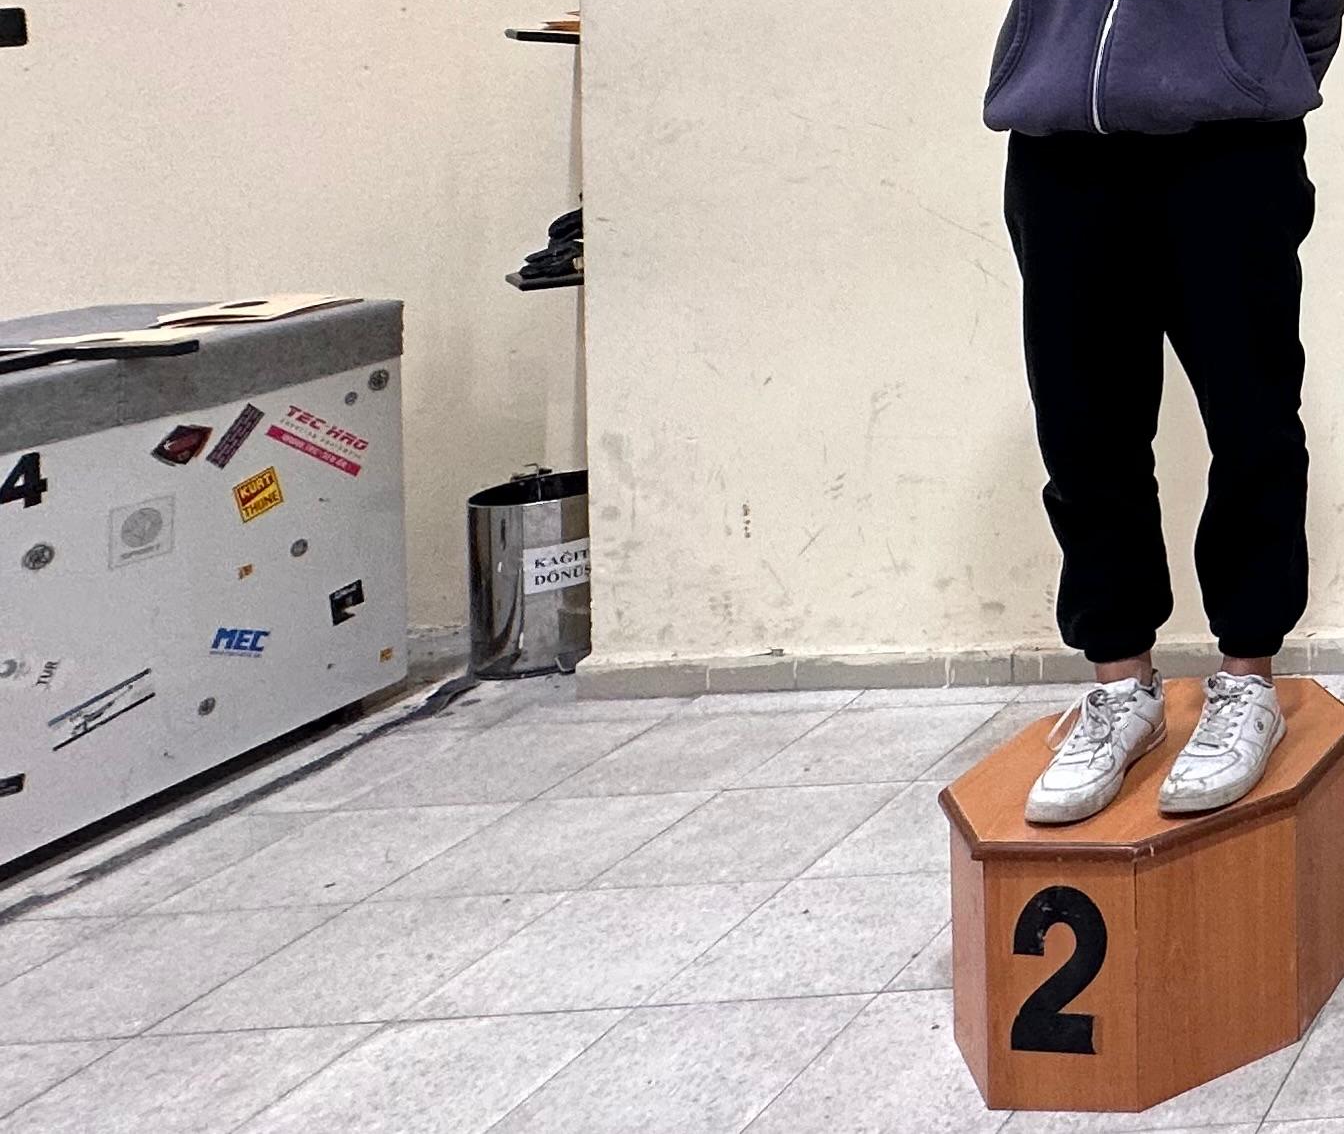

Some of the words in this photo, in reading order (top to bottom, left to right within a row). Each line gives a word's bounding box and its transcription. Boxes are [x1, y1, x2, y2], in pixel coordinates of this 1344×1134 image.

[240, 473, 273, 498] KURT
[211, 627, 271, 652] MEC
[1010, 885, 1108, 1055] 2
